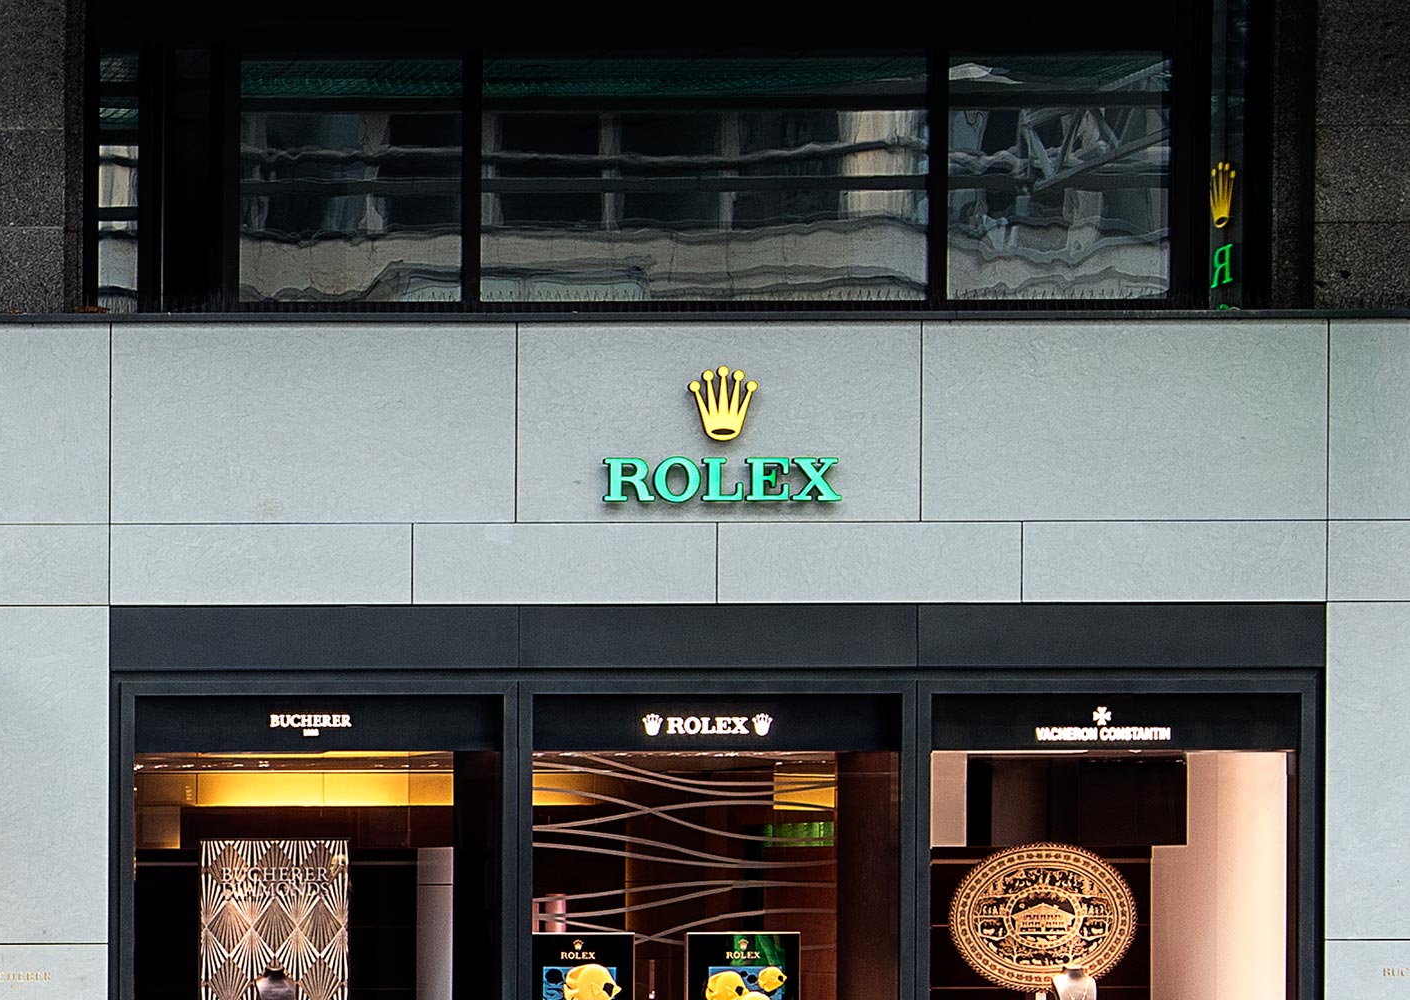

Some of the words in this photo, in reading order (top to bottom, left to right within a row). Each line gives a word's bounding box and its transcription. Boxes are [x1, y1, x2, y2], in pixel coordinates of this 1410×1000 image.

[602, 455, 843, 502] ROLEX
[269, 713, 352, 728] BUCHERER
[666, 716, 750, 735] ROLEX
[1035, 726, 1098, 741] VACHERON
[1099, 726, 1171, 741] CONSTANTIN
[221, 866, 329, 882] BUCHERER
[221, 882, 330, 897] DIAMONDS
[560, 951, 596, 960] ROLEX
[725, 951, 761, 960] ROLEX
